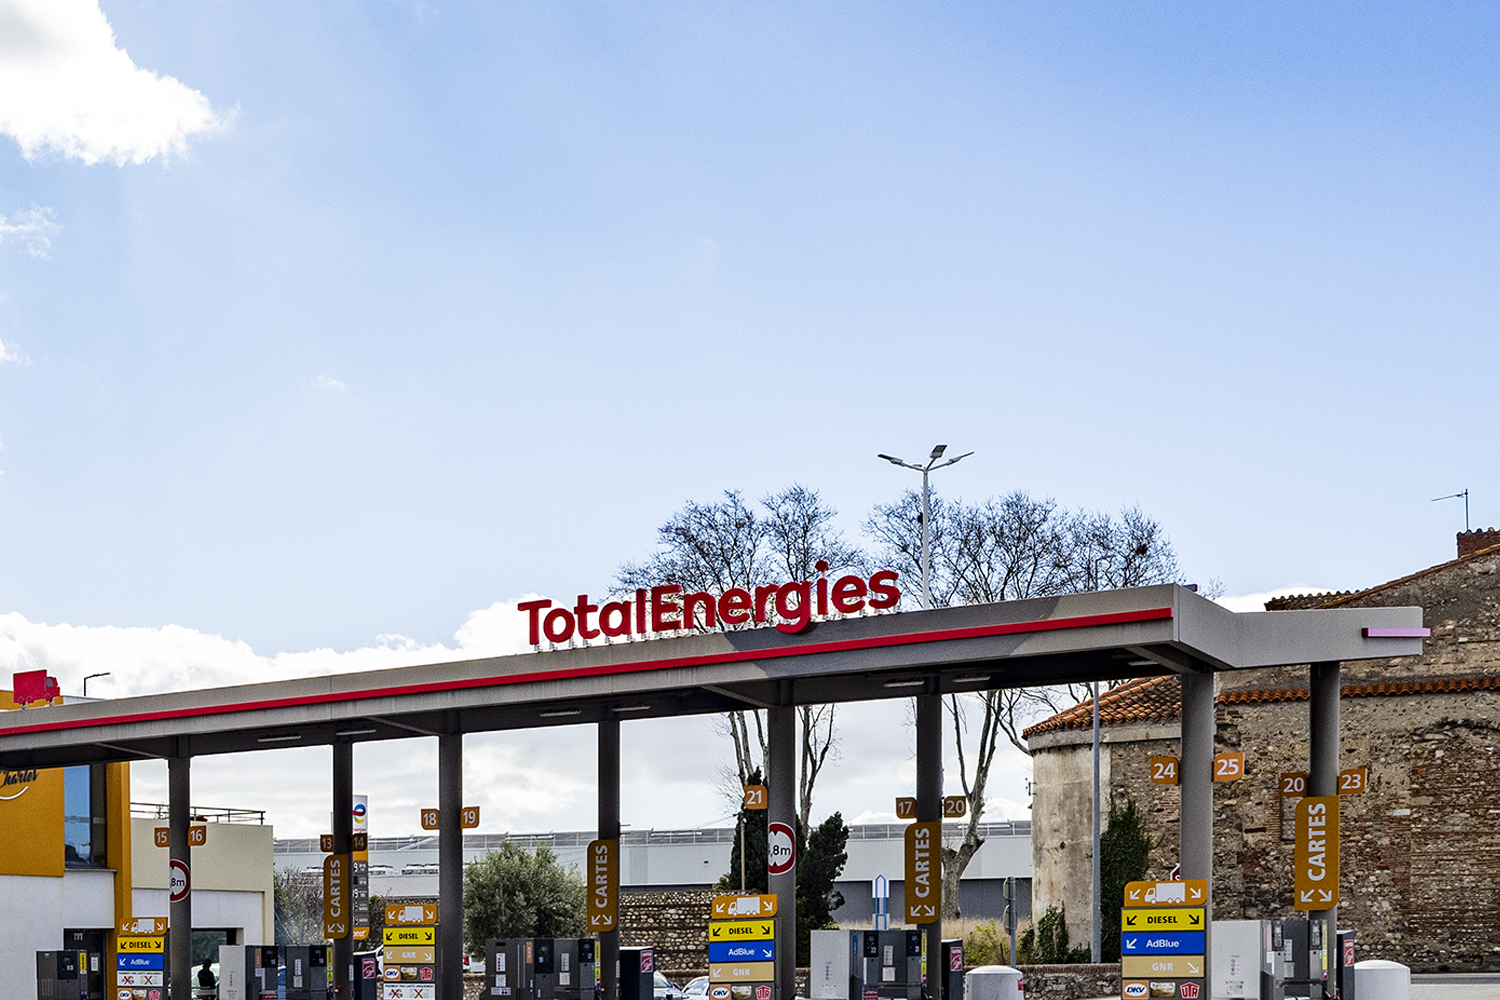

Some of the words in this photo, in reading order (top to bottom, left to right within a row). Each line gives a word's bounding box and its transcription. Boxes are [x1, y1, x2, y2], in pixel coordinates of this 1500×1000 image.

[517, 559, 901, 634] TotalEnergies
[1153, 762, 1176, 779] 24
[1217, 758, 1239, 776] 25
[1283, 777, 1304, 792] 20
[1341, 774, 1361, 789] 23
[746, 790, 762, 805] 21
[898, 801, 912, 815] 17
[946, 800, 965, 814] 20
[423, 812, 437, 826] 18
[463, 810, 476, 824] 19
[156, 831, 167, 843] 15
[190, 829, 203, 842] 16
[354, 837, 365, 847] 14
[1307, 802, 1327, 881] CARTES
[322, 838, 332, 849] 13
[915, 827, 930, 898] CARTES
[595, 844, 608, 908] CARTES
[330, 859, 341, 917] CARTES
[1147, 916, 1178, 924] DIESEL
[728, 927, 753, 935] DIESEL
[1146, 939, 1180, 948] AdBlue
[402, 951, 416, 959] GNR
[728, 948, 755, 956] AdBlue
[130, 958, 150, 966] AdBlue
[1152, 963, 1173, 972] GNR
[732, 968, 750, 976] GNR
